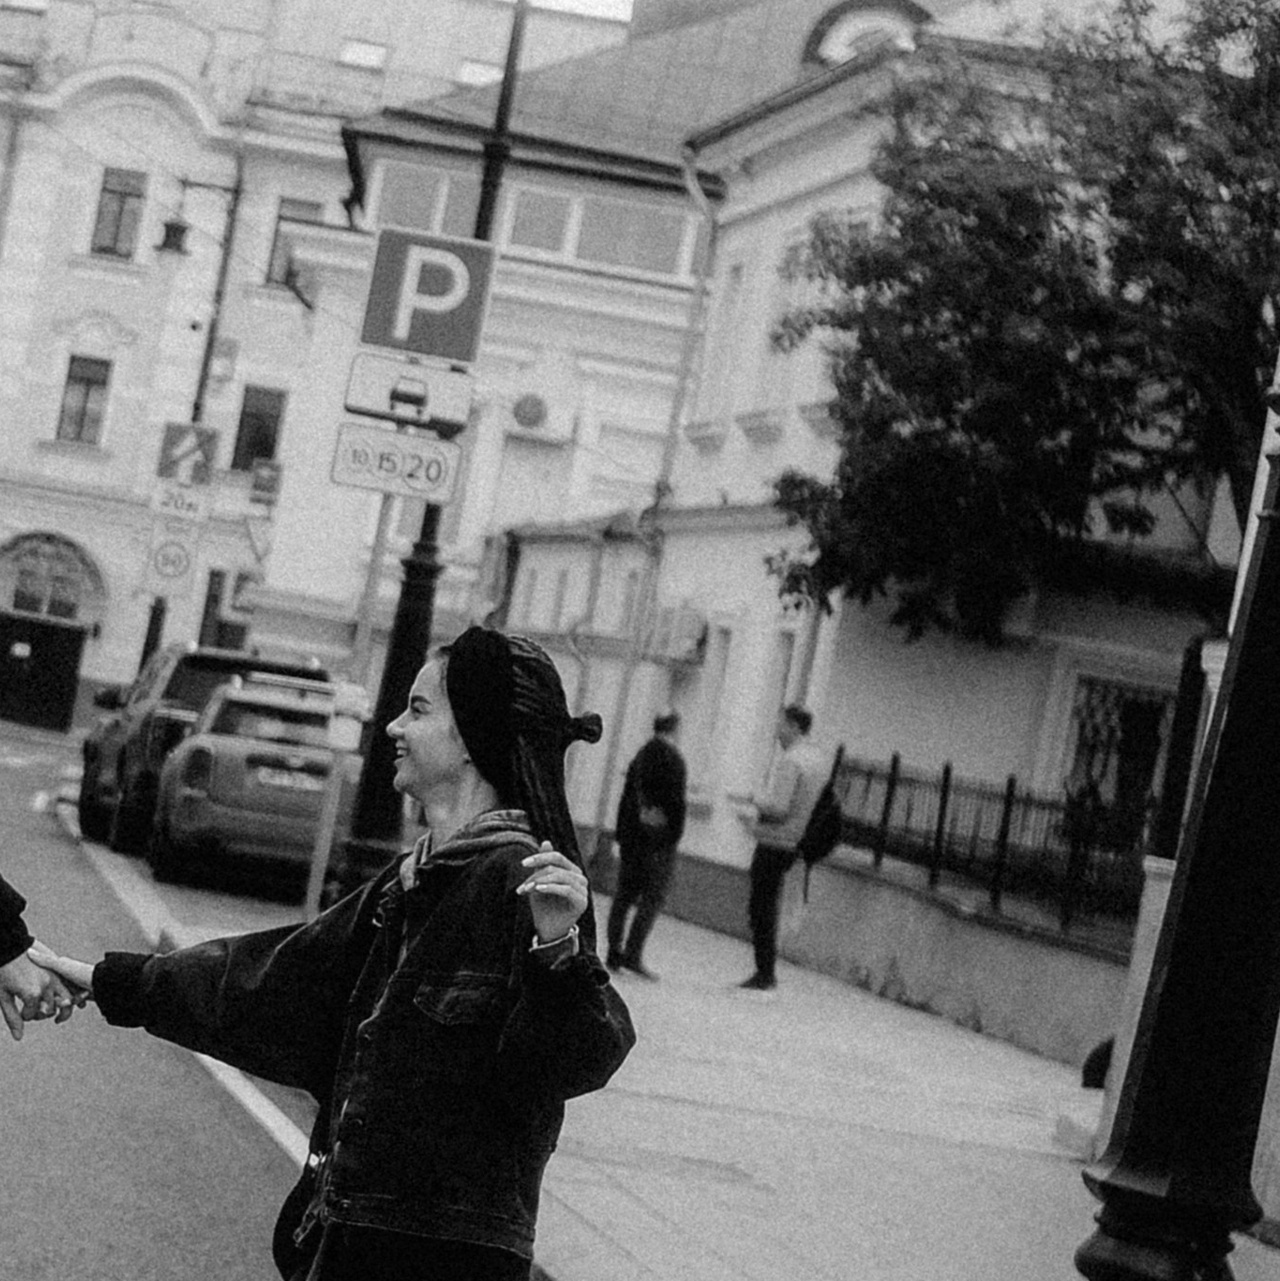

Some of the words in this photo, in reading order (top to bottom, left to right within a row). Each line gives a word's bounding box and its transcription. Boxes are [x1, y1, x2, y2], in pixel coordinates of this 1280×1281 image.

[392, 244, 470, 341] P
[378, 452, 397, 474] 15
[406, 453, 442, 483] 20
